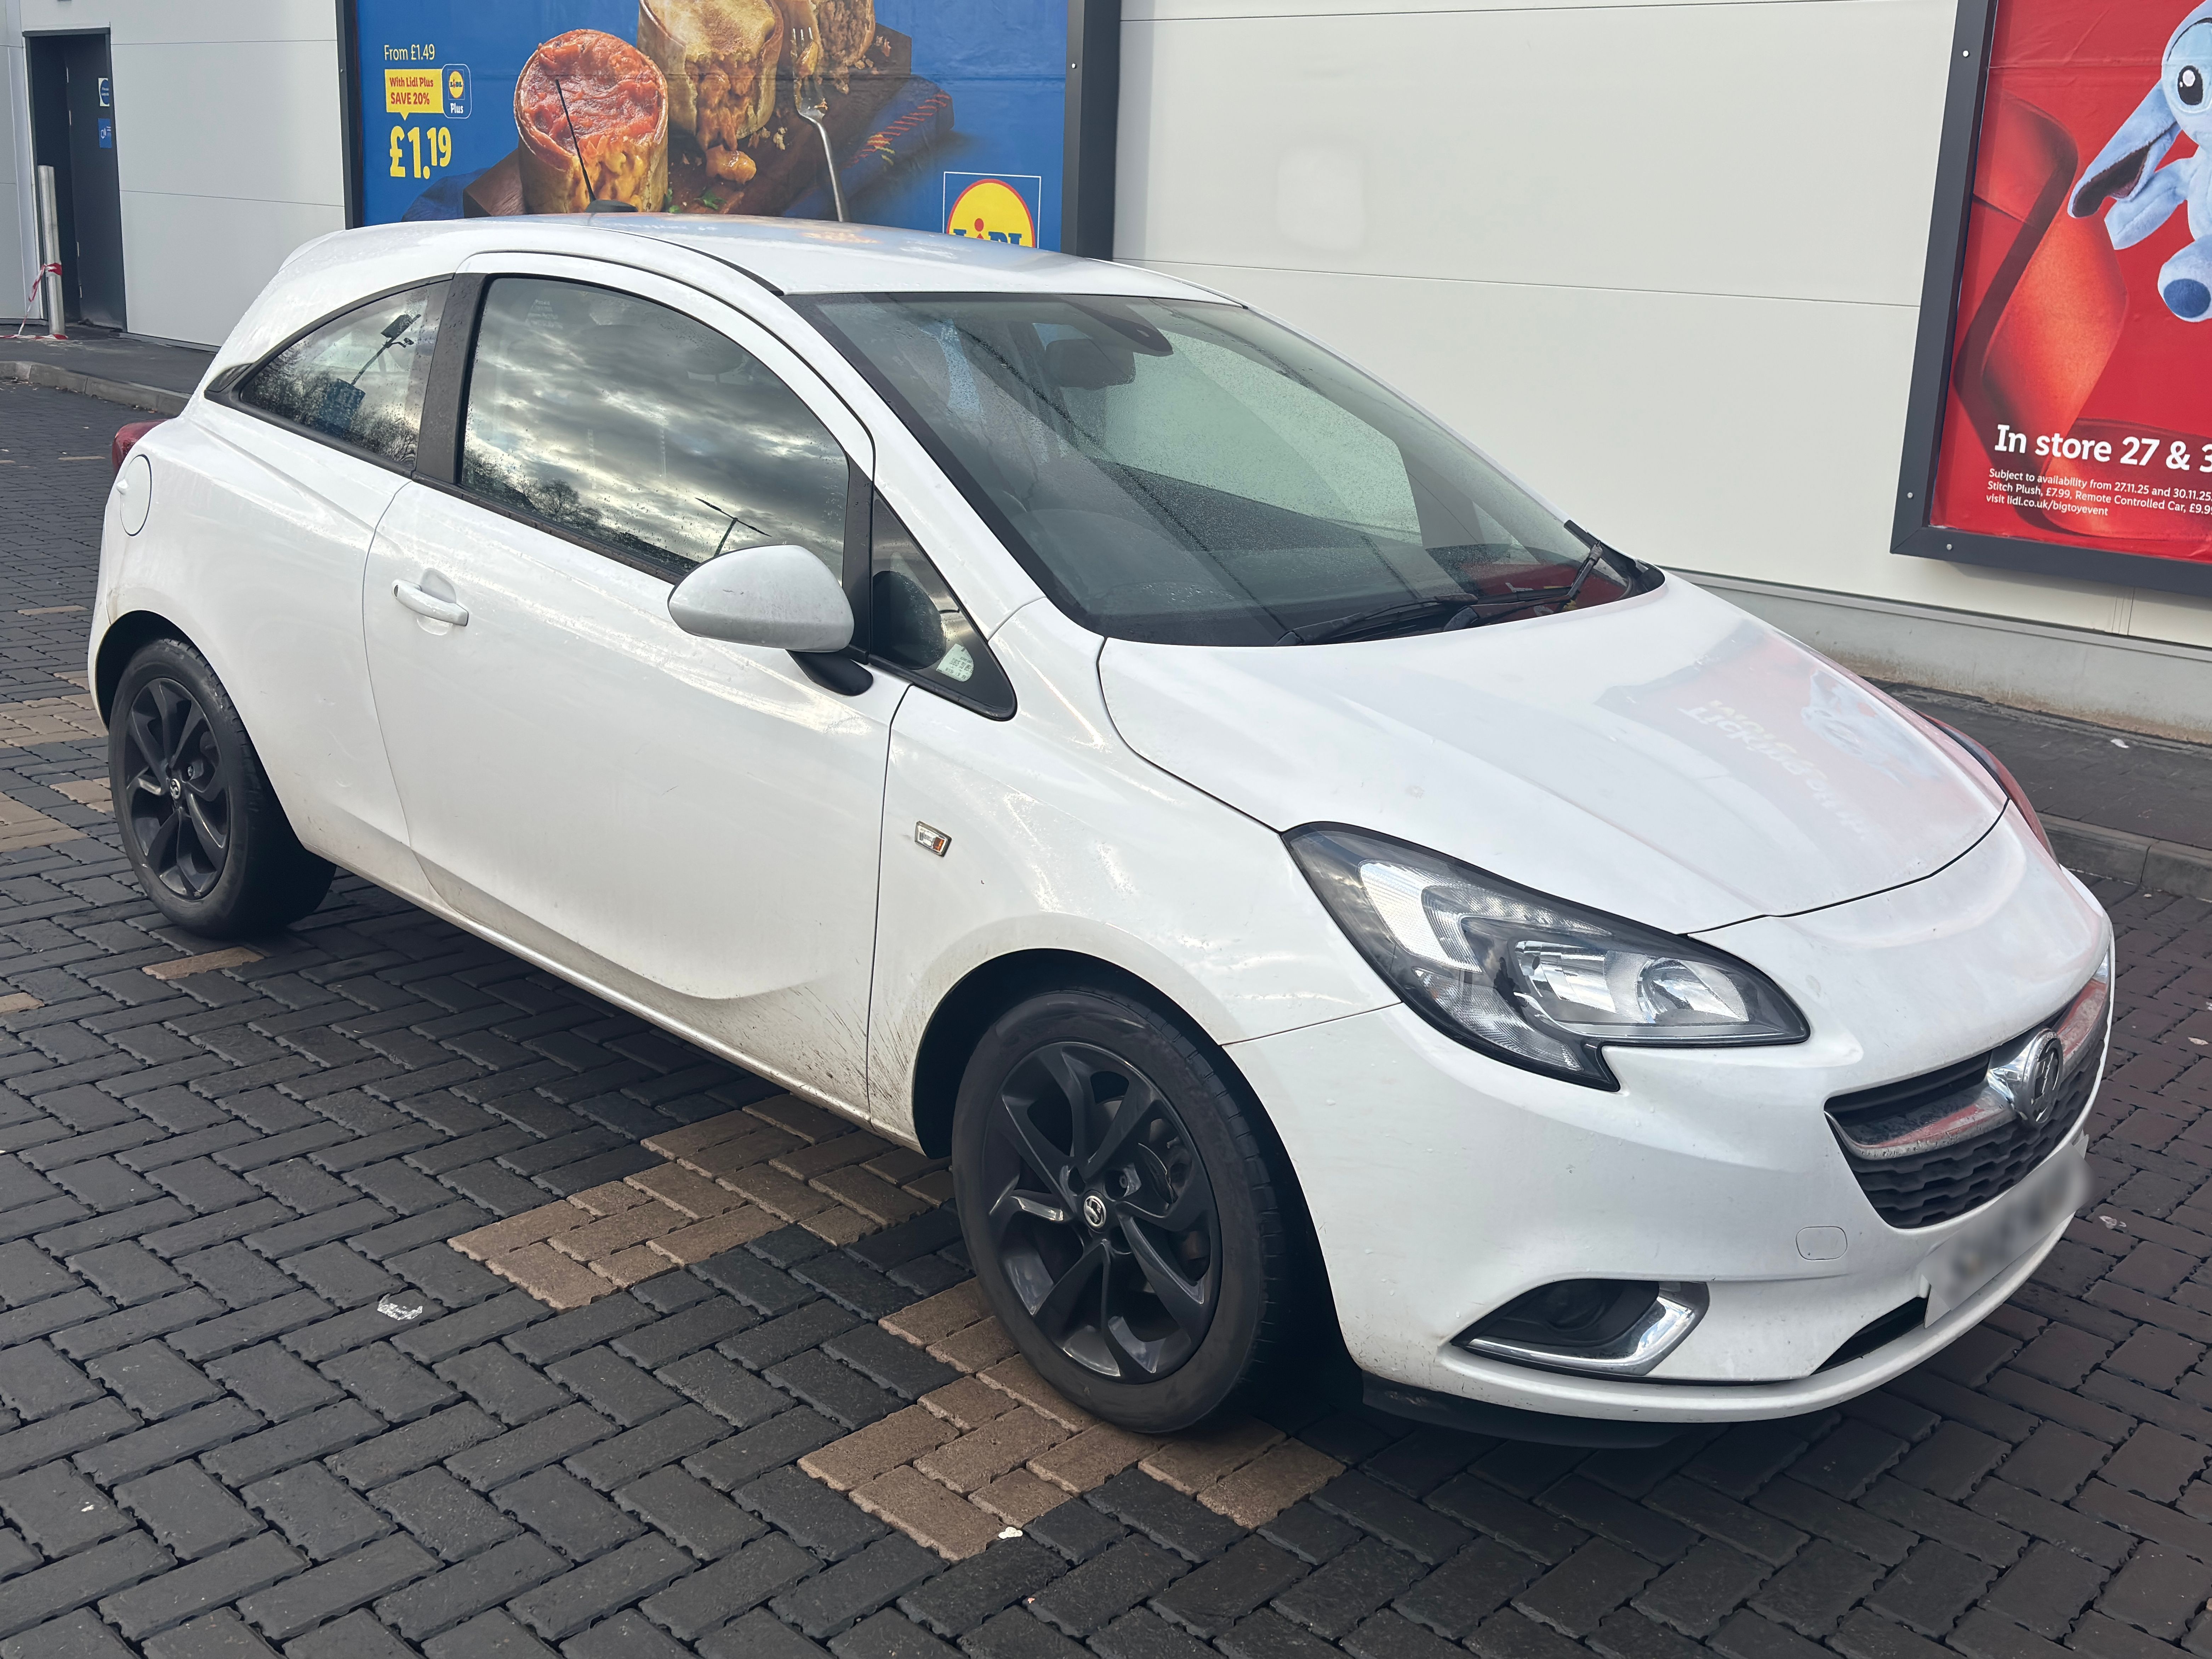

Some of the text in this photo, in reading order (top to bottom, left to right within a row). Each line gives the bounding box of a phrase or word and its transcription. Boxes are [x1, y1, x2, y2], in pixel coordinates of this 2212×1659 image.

[384, 44, 435, 60] From £1.49
[389, 76, 433, 87] With Lidl Plus
[391, 92, 430, 105] SAVE 20%
[450, 103, 463, 114] Plus
[390, 126, 451, 179] £1.19
[1995, 424, 2027, 454] In
[2035, 433, 2112, 462] store
[2120, 436, 2160, 466] 27
[2166, 441, 2190, 470] &
[1989, 468, 2023, 481] Subject
[2026, 473, 2035, 482] to
[2037, 475, 2087, 489] availability
[2090, 479, 2112, 490] from
[2114, 482, 2149, 494] 27.11.25
[2151, 487, 2171, 497] and
[1986, 493, 2109, 516] visit lidl.co.uk/bigtoyevent
[1988, 480, 2013, 492] Stitch
[2016, 484, 2043, 496] Plush,
[2075, 490, 2111, 503] Remote
[2114, 495, 2165, 509] Controlled
[2168, 501, 2186, 513] Car,
[2189, 503, 2212, 515] £9.9
